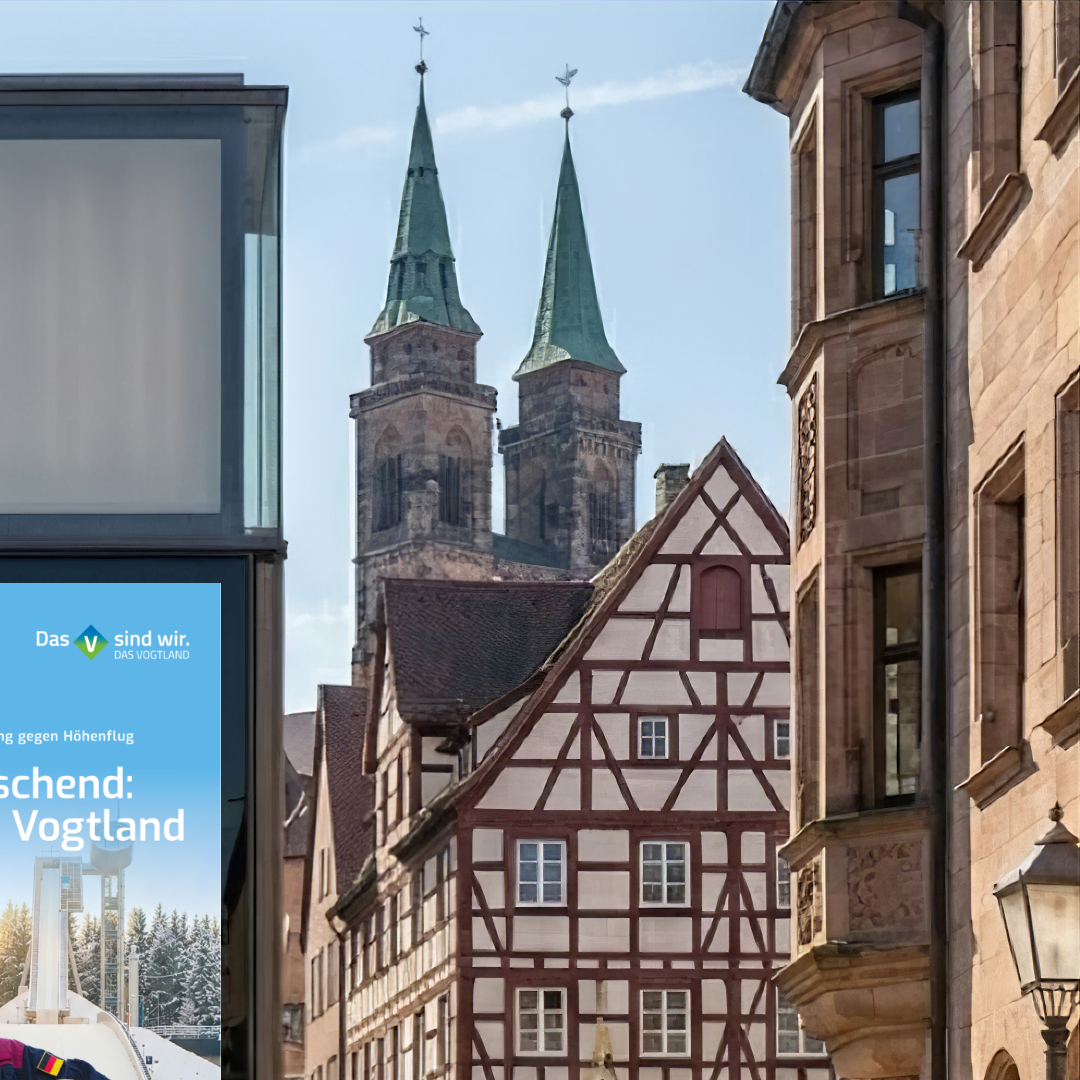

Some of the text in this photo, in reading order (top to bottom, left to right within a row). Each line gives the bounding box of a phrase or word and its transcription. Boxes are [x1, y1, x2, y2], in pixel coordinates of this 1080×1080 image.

[36, 630, 190, 653] Das V sind wir.
[114, 650, 190, 660] DAS VOGTLAND
[17, 732, 59, 745] gegen
[63, 729, 135, 745] Höhenflug
[11, 808, 185, 852] Vogtland
